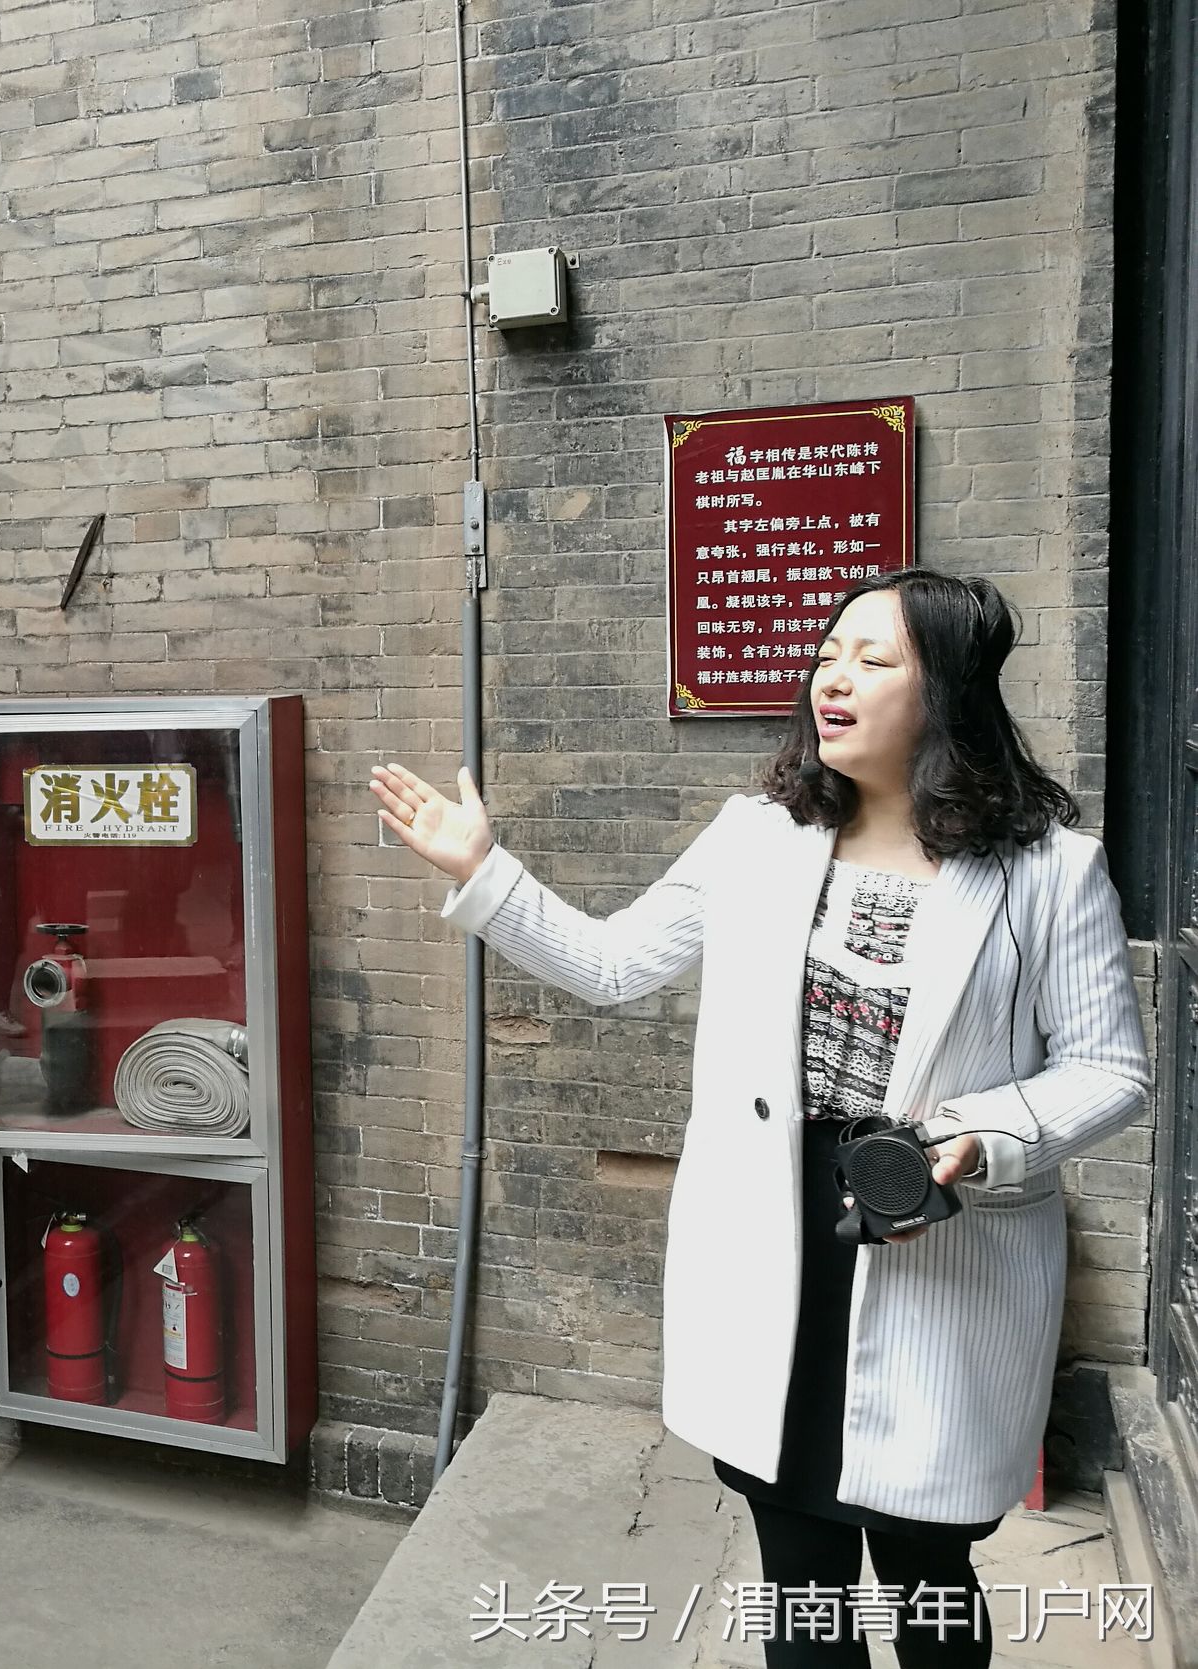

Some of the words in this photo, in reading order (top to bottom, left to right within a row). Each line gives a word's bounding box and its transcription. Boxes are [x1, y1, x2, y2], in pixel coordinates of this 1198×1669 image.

[695, 460, 882, 485] 老祖与赵匡胤在华山东峰下
[695, 493, 764, 510] 棋时所写。
[723, 512, 881, 534] 其字左偏旁上点，被有
[695, 539, 881, 560] 意夸张，强行美化，形如一
[39, 772, 182, 824] 消火栓
[44, 824, 84, 832] FIRE
[102, 824, 179, 832] HYDRANT
